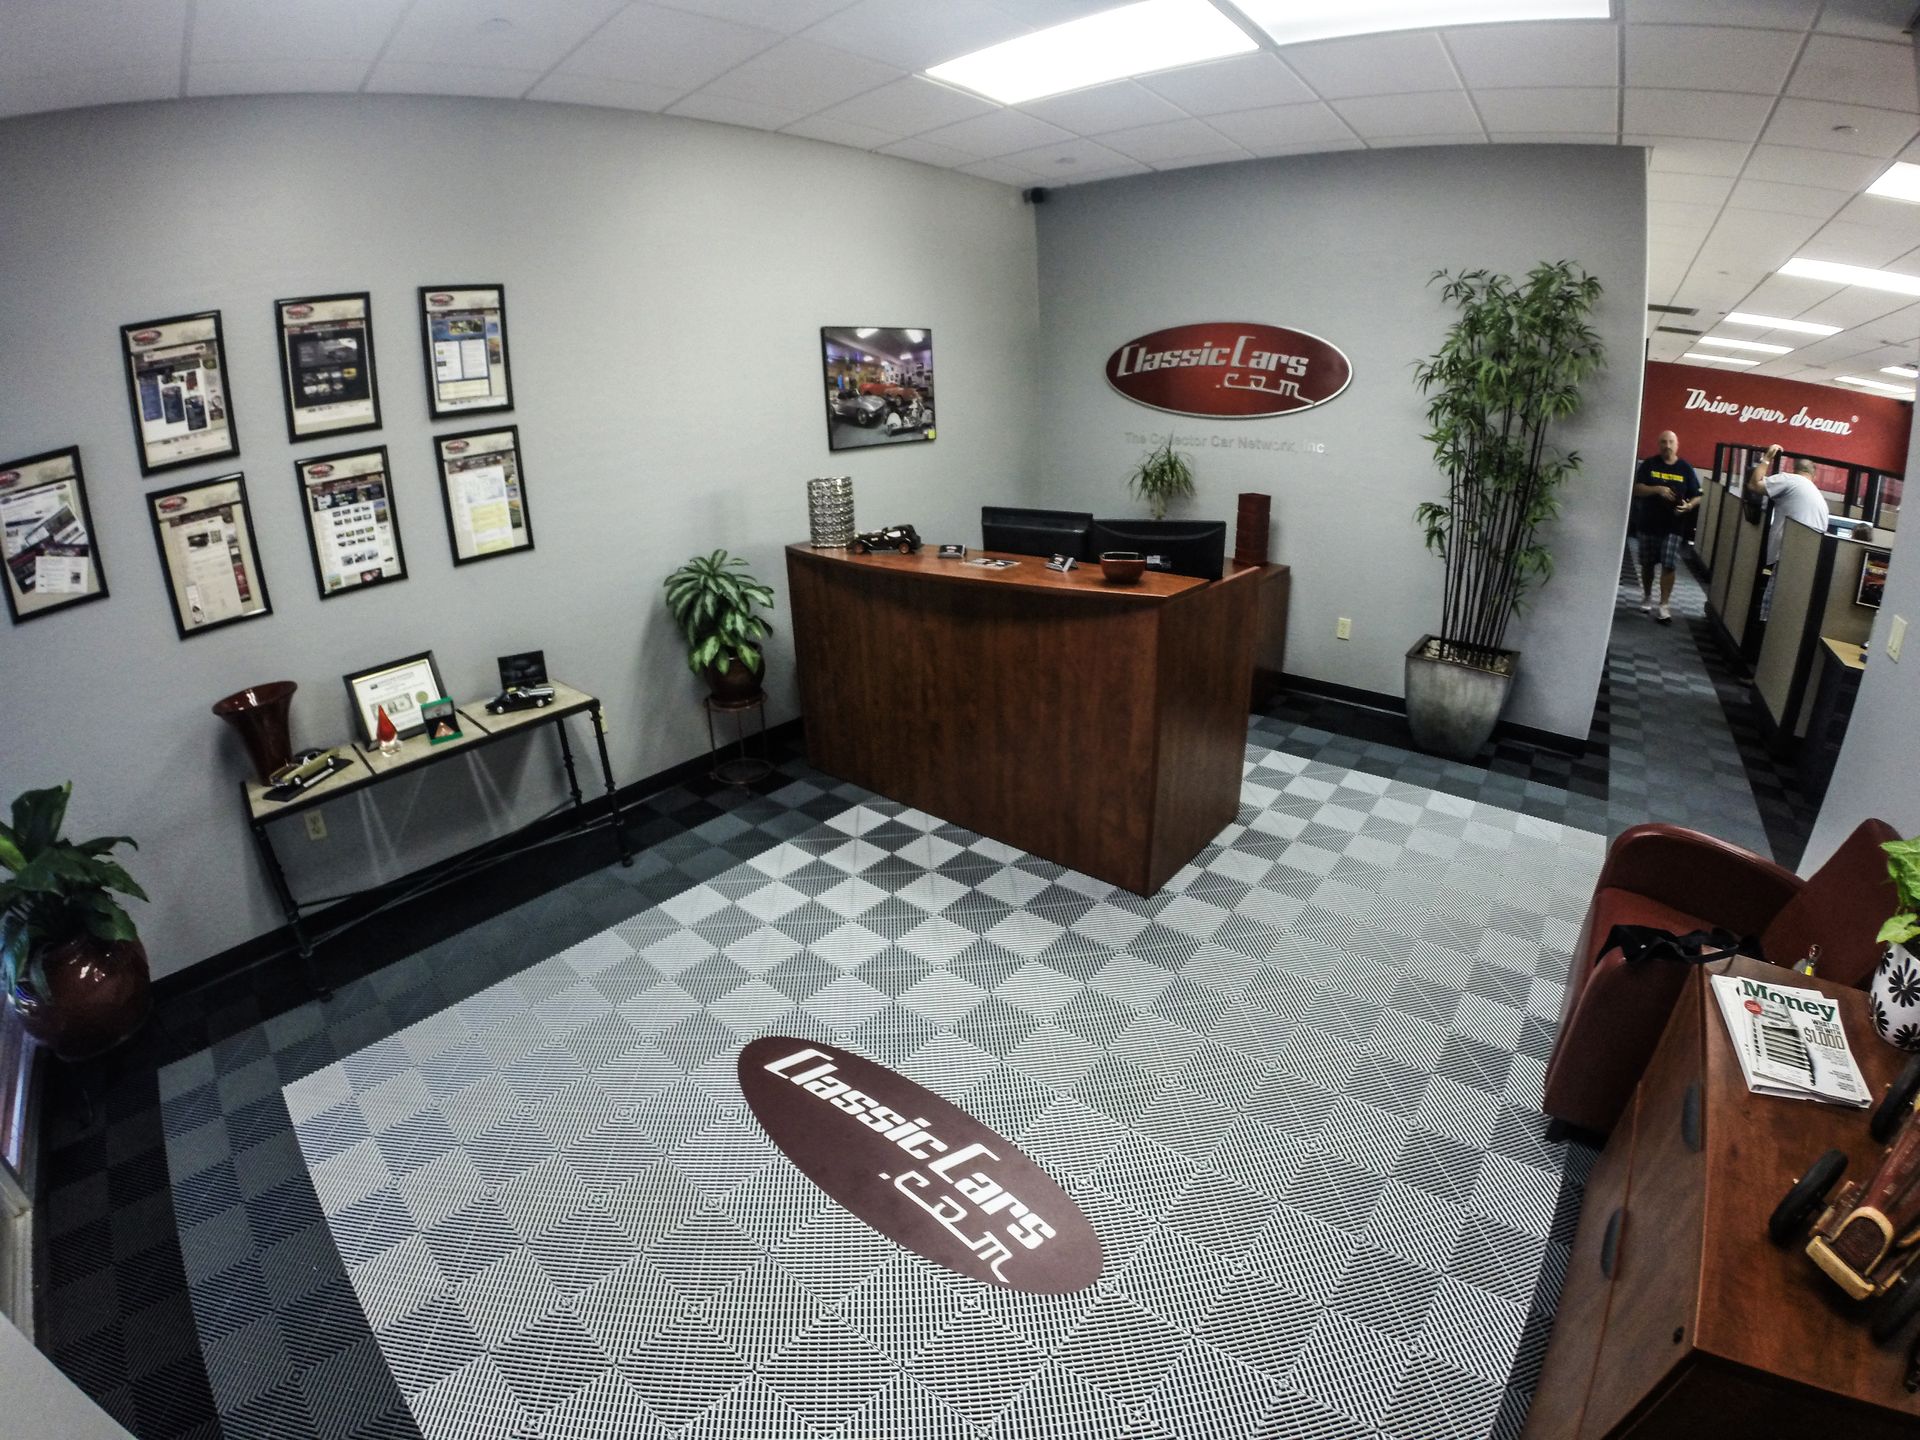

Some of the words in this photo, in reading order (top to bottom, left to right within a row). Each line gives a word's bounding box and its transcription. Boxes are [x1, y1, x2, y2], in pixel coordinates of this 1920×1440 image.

[1216, 373, 1316, 405] .com
[1684, 388, 1739, 416] Drive
[1739, 403, 1787, 423] your
[1124, 432, 1146, 444] The
[1211, 435, 1234, 448] Car
[1741, 980, 1836, 1022] Money
[878, 1170, 1013, 1283] .com
